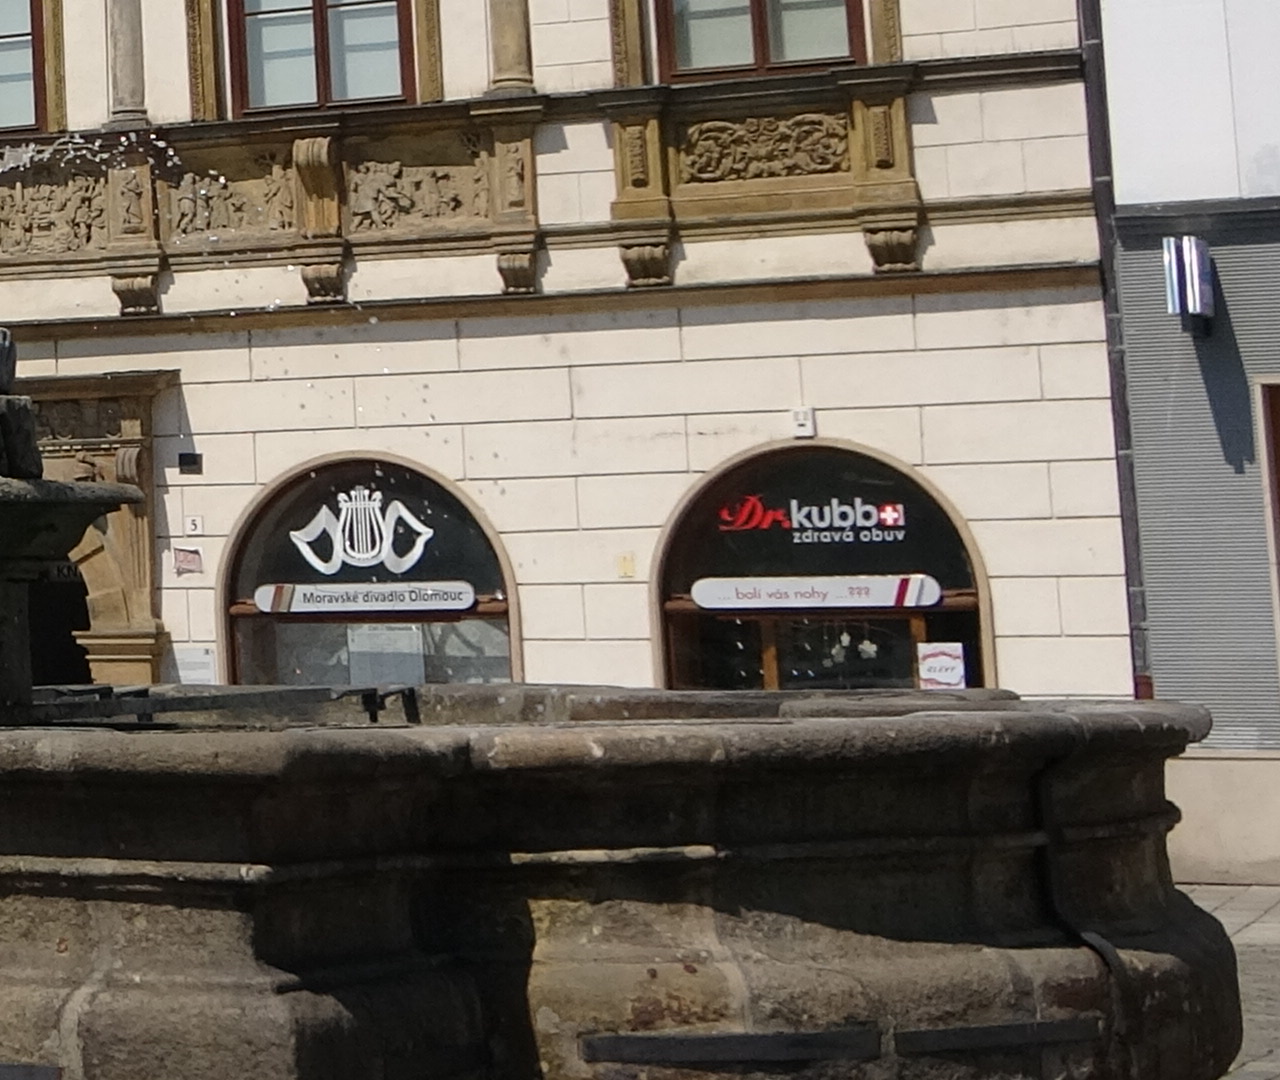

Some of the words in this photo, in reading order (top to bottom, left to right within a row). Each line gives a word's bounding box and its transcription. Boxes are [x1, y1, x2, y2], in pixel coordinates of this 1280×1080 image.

[190, 519, 198, 531] 5
[792, 528, 854, 543] zdravá
[859, 529, 906, 542] obuv
[302, 590, 359, 604] Moravské
[362, 590, 406, 603] divadlo
[409, 590, 464, 602] Olomouc
[767, 588, 790, 600] vás
[794, 585, 829, 602] nohy
